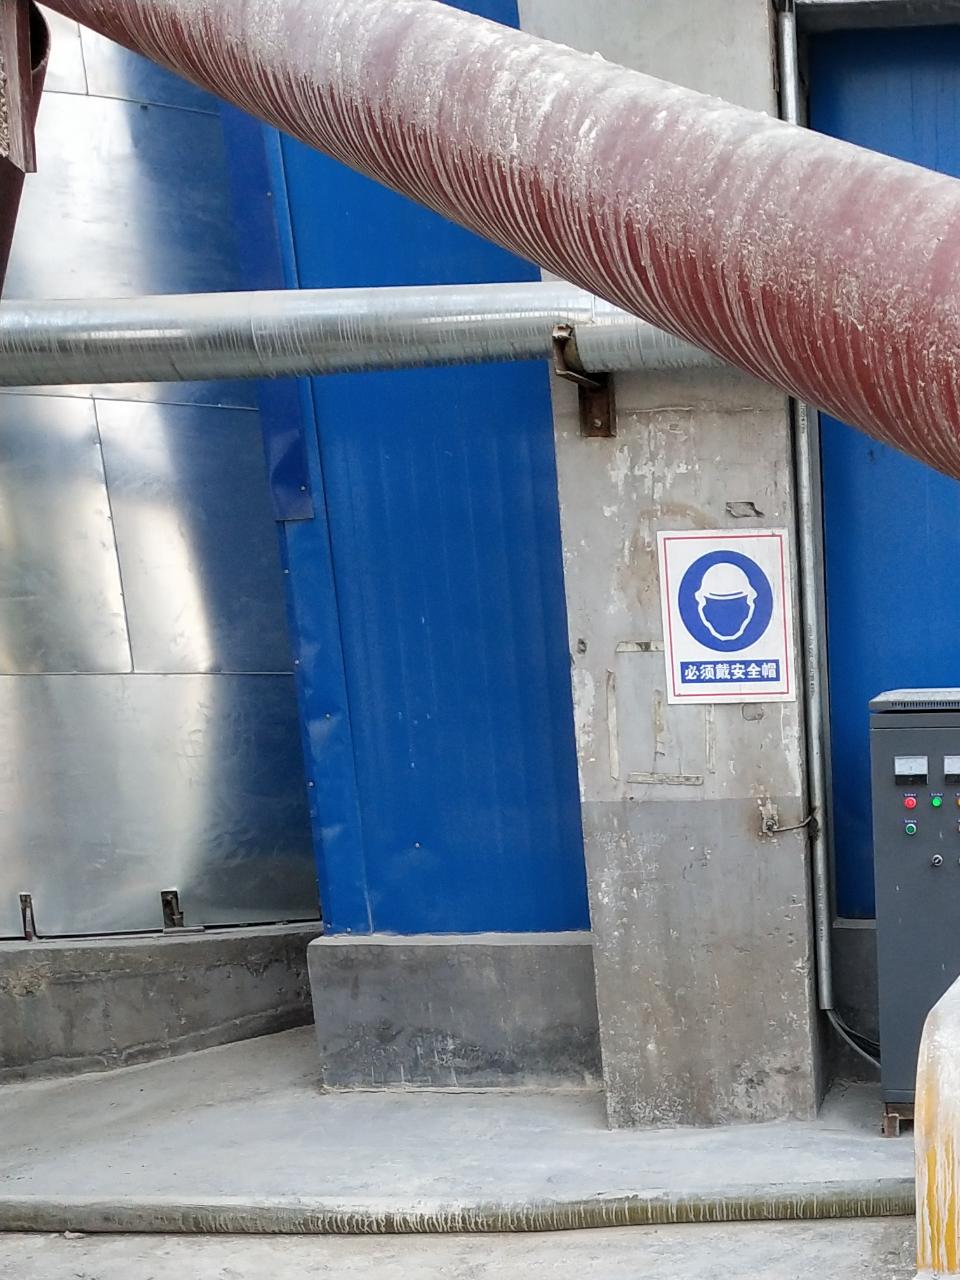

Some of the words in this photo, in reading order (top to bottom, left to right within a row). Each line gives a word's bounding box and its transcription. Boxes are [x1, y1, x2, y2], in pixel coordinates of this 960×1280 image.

[684, 662, 777, 680] 必须戴安全帽
